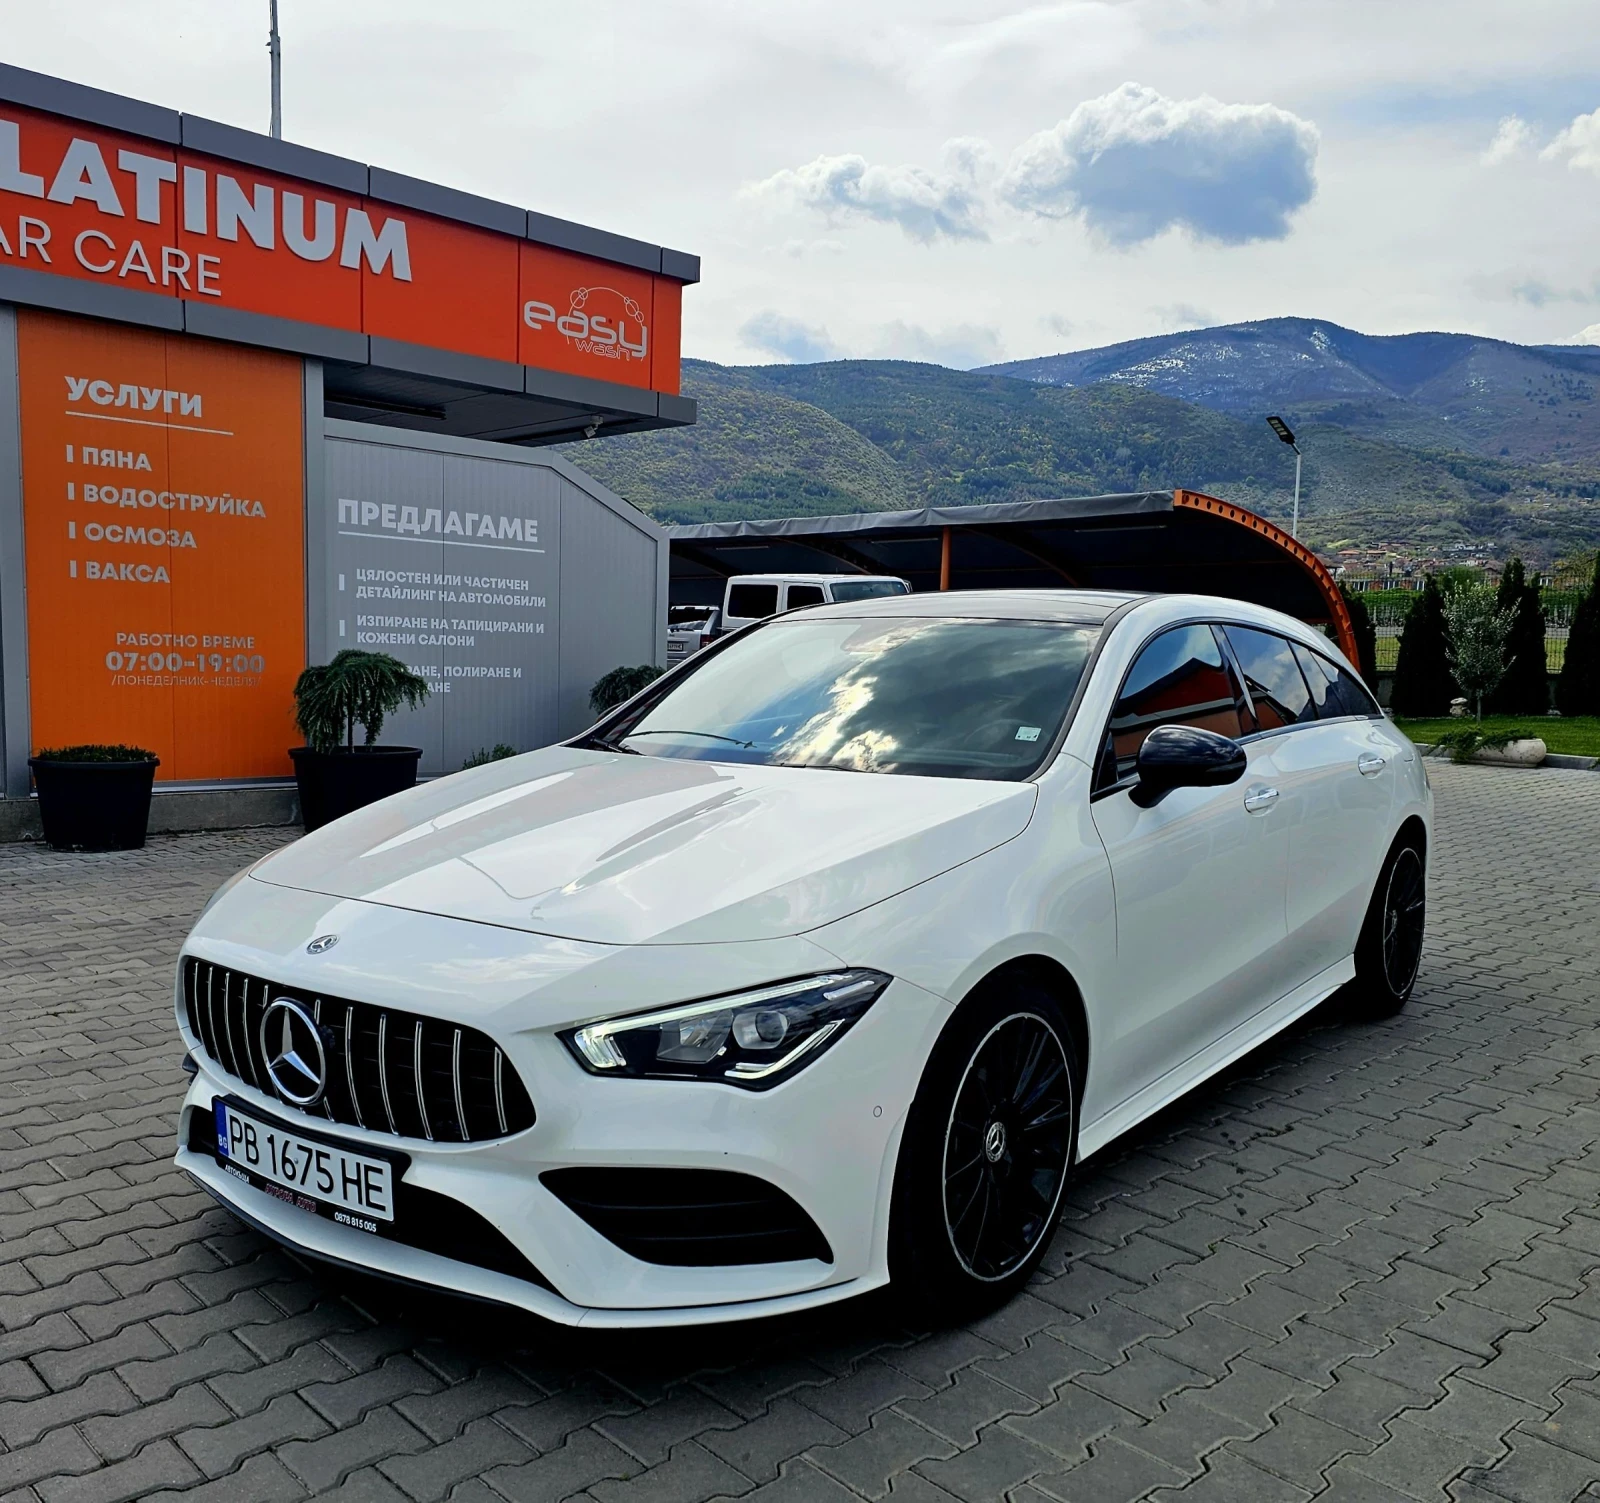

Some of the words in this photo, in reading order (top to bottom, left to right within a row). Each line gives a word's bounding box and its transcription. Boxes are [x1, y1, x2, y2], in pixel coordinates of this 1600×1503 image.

[0, 118, 412, 282] LATINUM
[74, 229, 222, 297] CARE
[524, 300, 648, 358] easy
[574, 338, 631, 362] wash
[64, 375, 202, 418] УСЛУГИ
[82, 446, 152, 471] ПЯНА
[84, 485, 266, 518] ВОДОСТРУЙКА
[338, 498, 538, 543] ПРЕДЛАГАМЕ
[84, 522, 198, 549] ОСМОЗА
[86, 560, 170, 583] ВАКСА
[356, 568, 431, 584] ЦЯЛОСТЕН
[433, 573, 461, 586] ИЛИ
[463, 575, 529, 591] ЧАСТИЧЕН
[356, 585, 436, 601] ДЕТАЙЛИНГ
[438, 590, 457, 602] НА
[458, 592, 546, 607] АВТОМОБИЛИ
[356, 614, 428, 629] ИЗПИРАНЕ
[430, 618, 449, 630] НА
[451, 619, 534, 633] ТАПИЦИРАНИ
[535, 623, 545, 634] И
[116, 632, 198, 647] РАБОТНО
[202, 635, 255, 649] ВРЕМЕ
[356, 631, 416, 645] КОЖЕНИ
[418, 633, 475, 647] САЛОНИ
[105, 651, 265, 673] 07:00-19:00
[443, 666, 511, 678] ПОЛИРАНЕ
[513, 667, 522, 678] И
[267, 1134, 335, 1194] 1675
[334, 1211, 351, 1225] 0878
[351, 1216, 364, 1229] 815
[363, 1220, 377, 1233] 005
